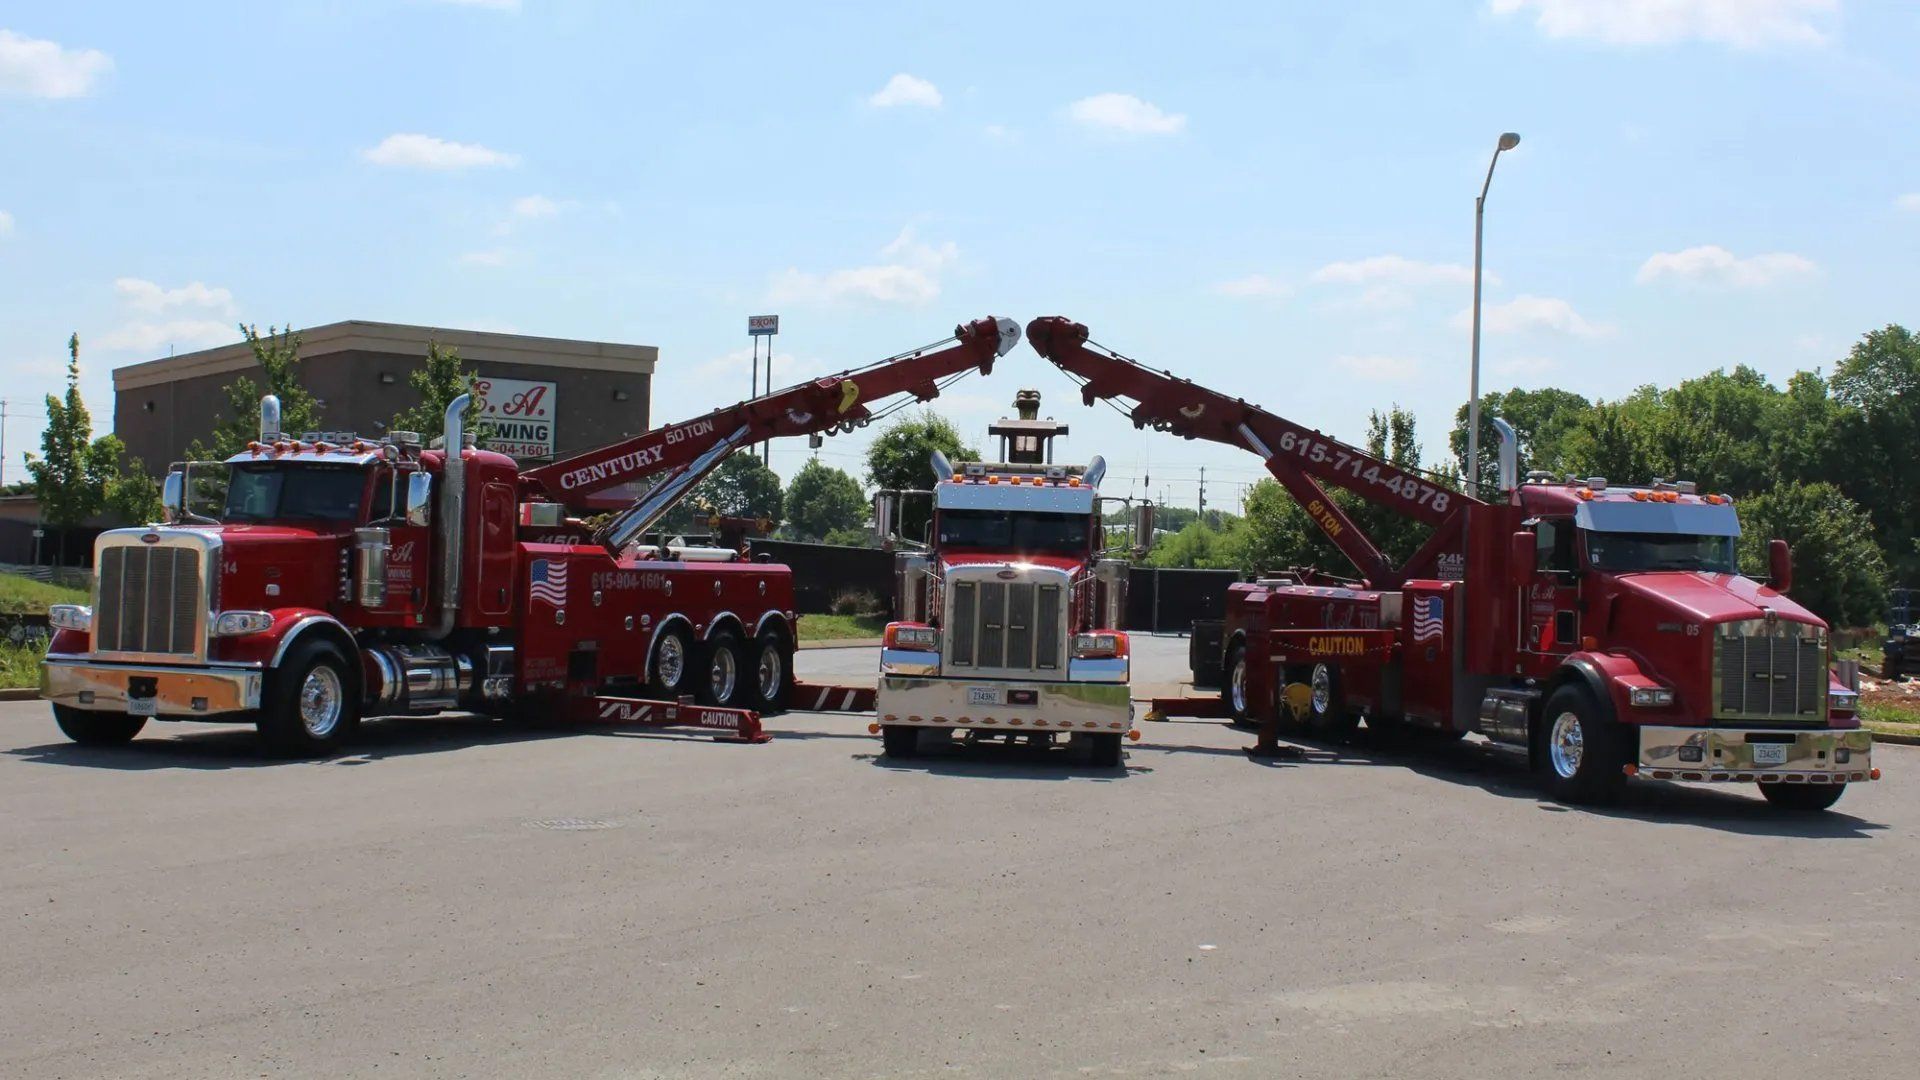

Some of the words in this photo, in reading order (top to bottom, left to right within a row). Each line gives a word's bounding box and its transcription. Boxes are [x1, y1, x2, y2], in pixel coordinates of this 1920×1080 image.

[480, 421, 548, 441] WING
[684, 419, 714, 438] TON
[560, 444, 664, 490] CENTURY
[1280, 431, 1450, 513] 615-714-4878
[1321, 511, 1343, 536] TON
[223, 561, 238, 574] 14
[592, 572, 666, 589] 615-904-1601
[1309, 636, 1364, 655] CAUTION
[701, 711, 738, 727] CAUTION
